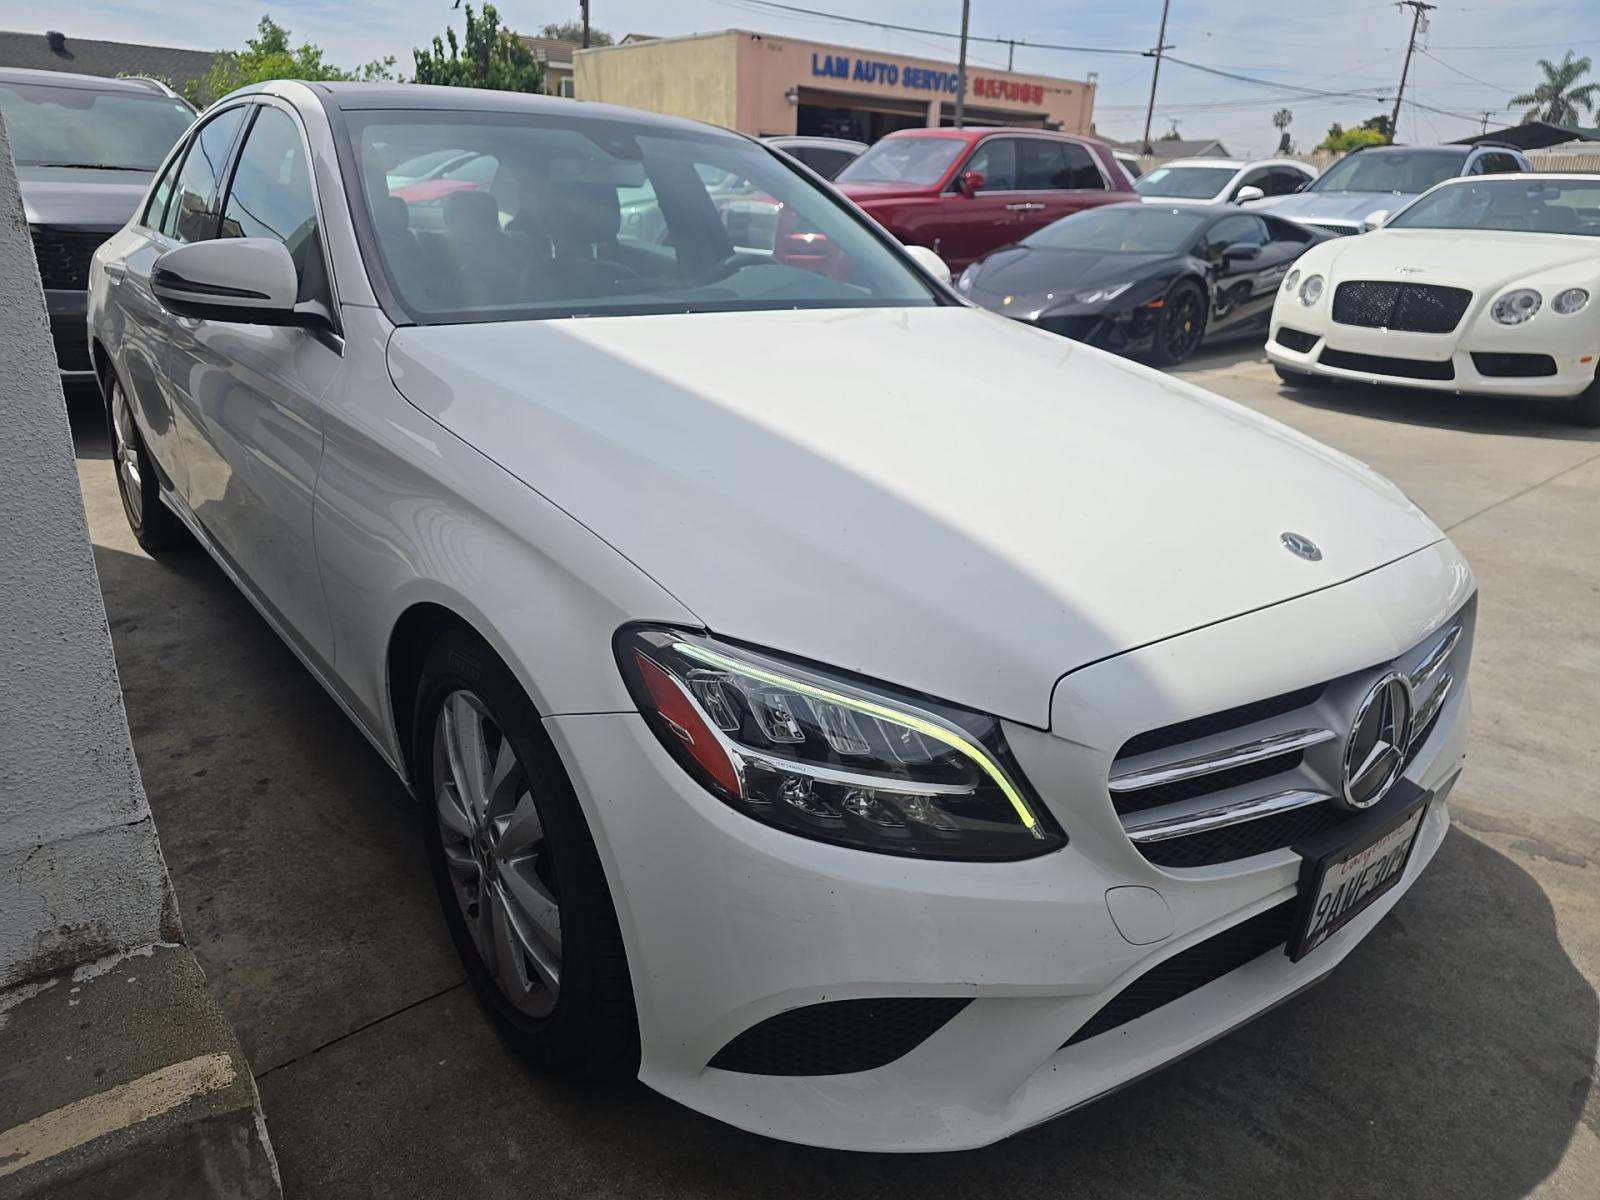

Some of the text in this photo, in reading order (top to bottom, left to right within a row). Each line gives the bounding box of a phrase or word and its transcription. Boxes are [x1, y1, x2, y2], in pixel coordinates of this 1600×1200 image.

[812, 53, 967, 94] LAM AUTO SERVIC
